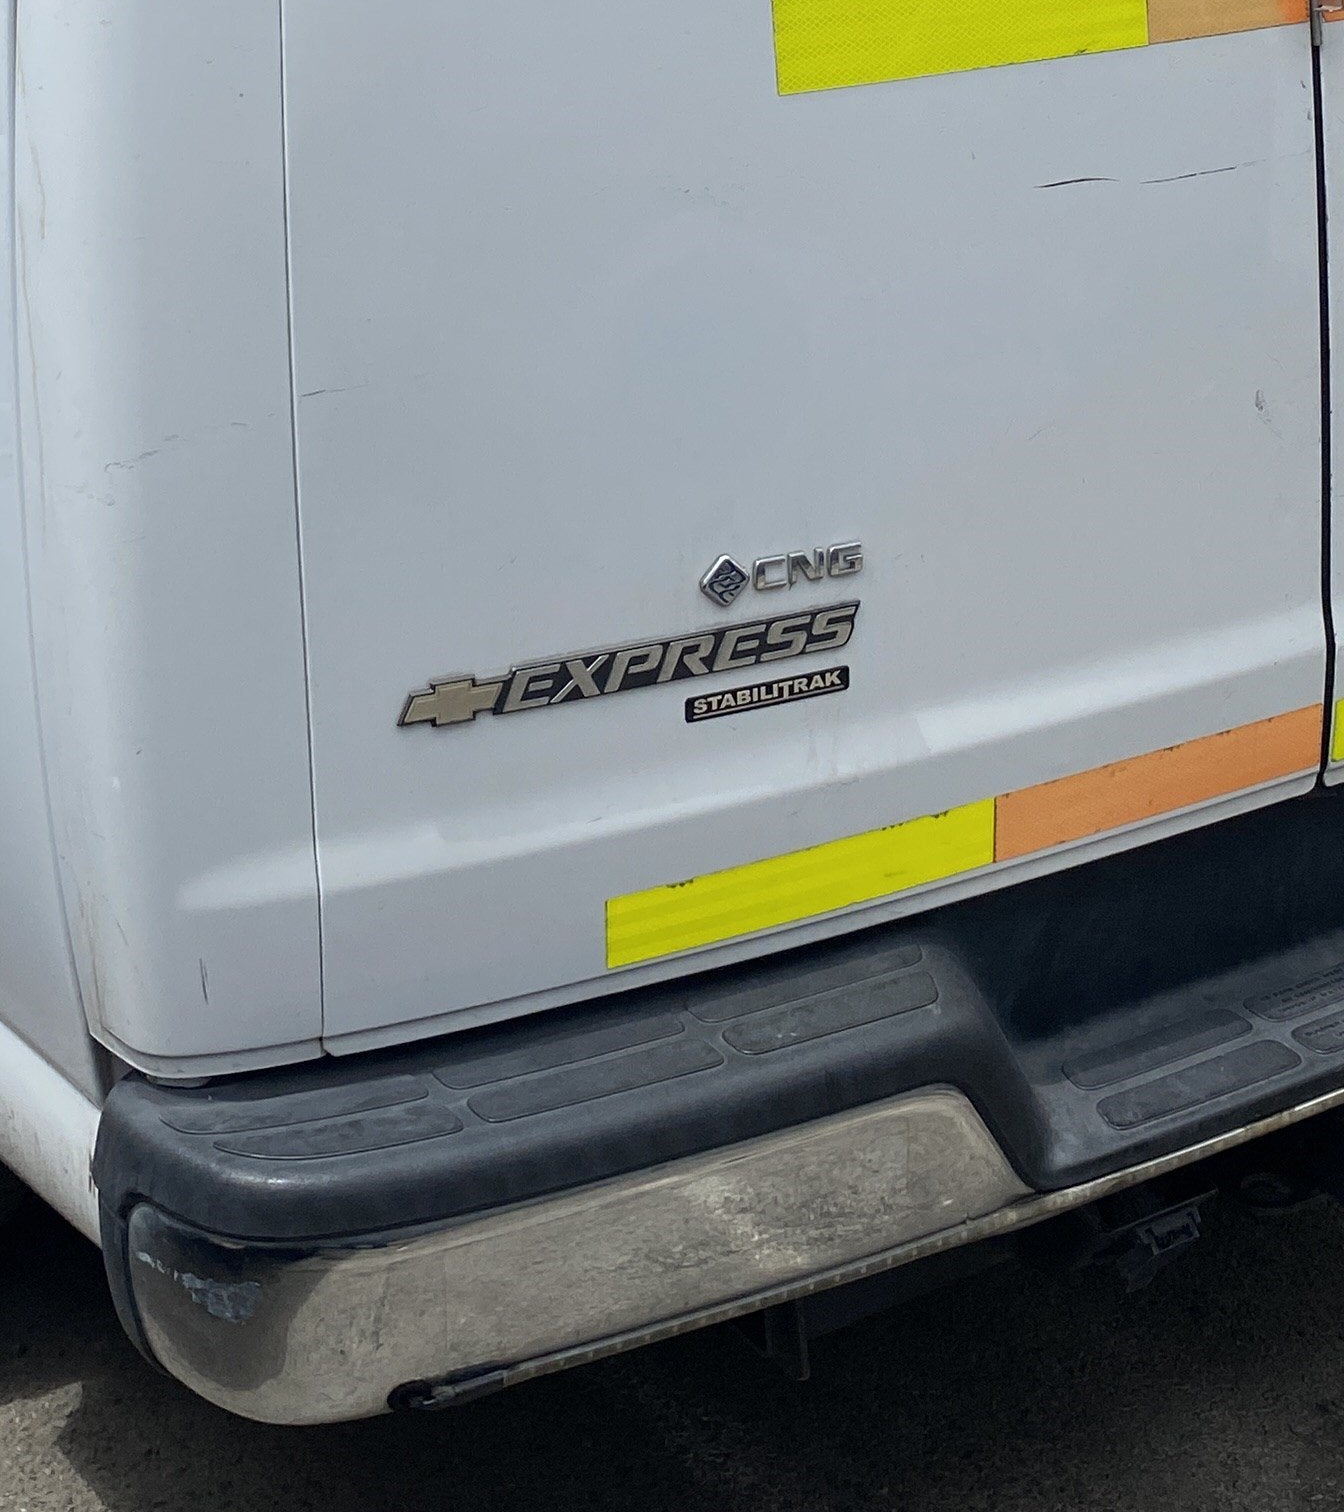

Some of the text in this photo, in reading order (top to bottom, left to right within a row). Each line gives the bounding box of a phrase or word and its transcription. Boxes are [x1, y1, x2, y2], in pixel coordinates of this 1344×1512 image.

[751, 541, 863, 592] CNG
[503, 604, 858, 713] EXPRESS
[692, 668, 843, 716] STABILITRAK
